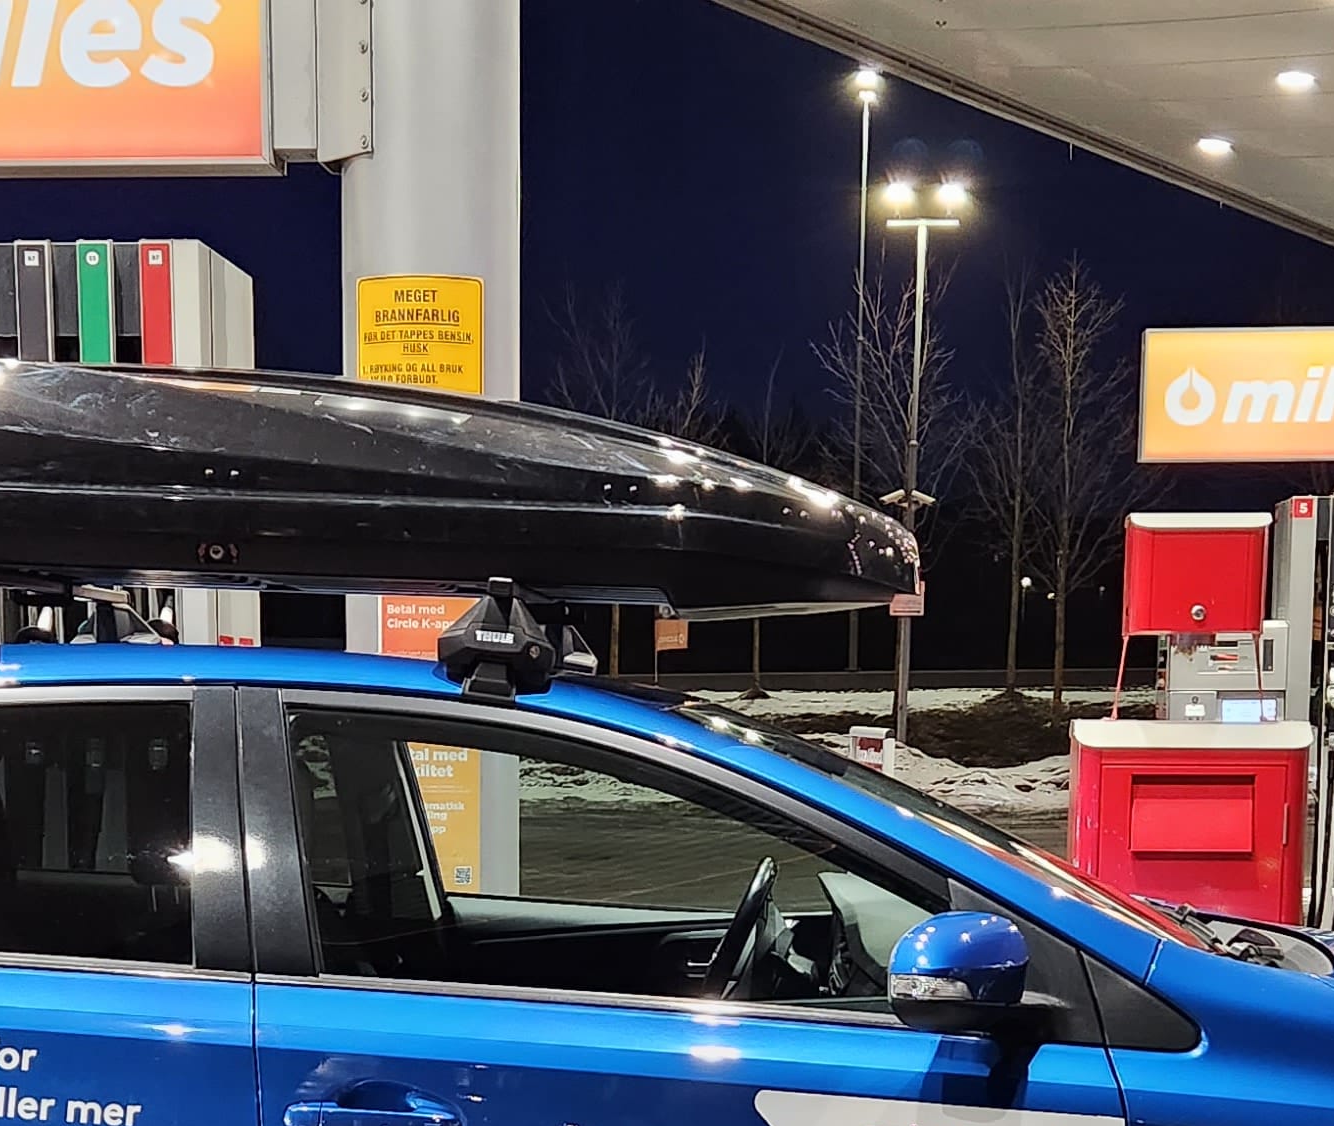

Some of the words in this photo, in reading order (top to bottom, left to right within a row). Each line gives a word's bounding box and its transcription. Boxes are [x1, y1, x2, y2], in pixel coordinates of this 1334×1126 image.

[394, 289, 438, 303] MEGET
[375, 308, 460, 323] BRANNFARLIG
[380, 330, 396, 340] DET
[399, 330, 435, 340] TAPPES
[402, 343, 429, 353] HUSK
[405, 363, 418, 373] OG
[420, 363, 437, 373] ALL
[439, 363, 464, 374] BRUK
[1299, 502, 1308, 514] 5
[386, 604, 416, 615] Betal
[418, 604, 445, 615] med
[386, 618, 419, 629] Circle
[475, 629, 515, 644] THULE
[432, 749, 468, 762] med
